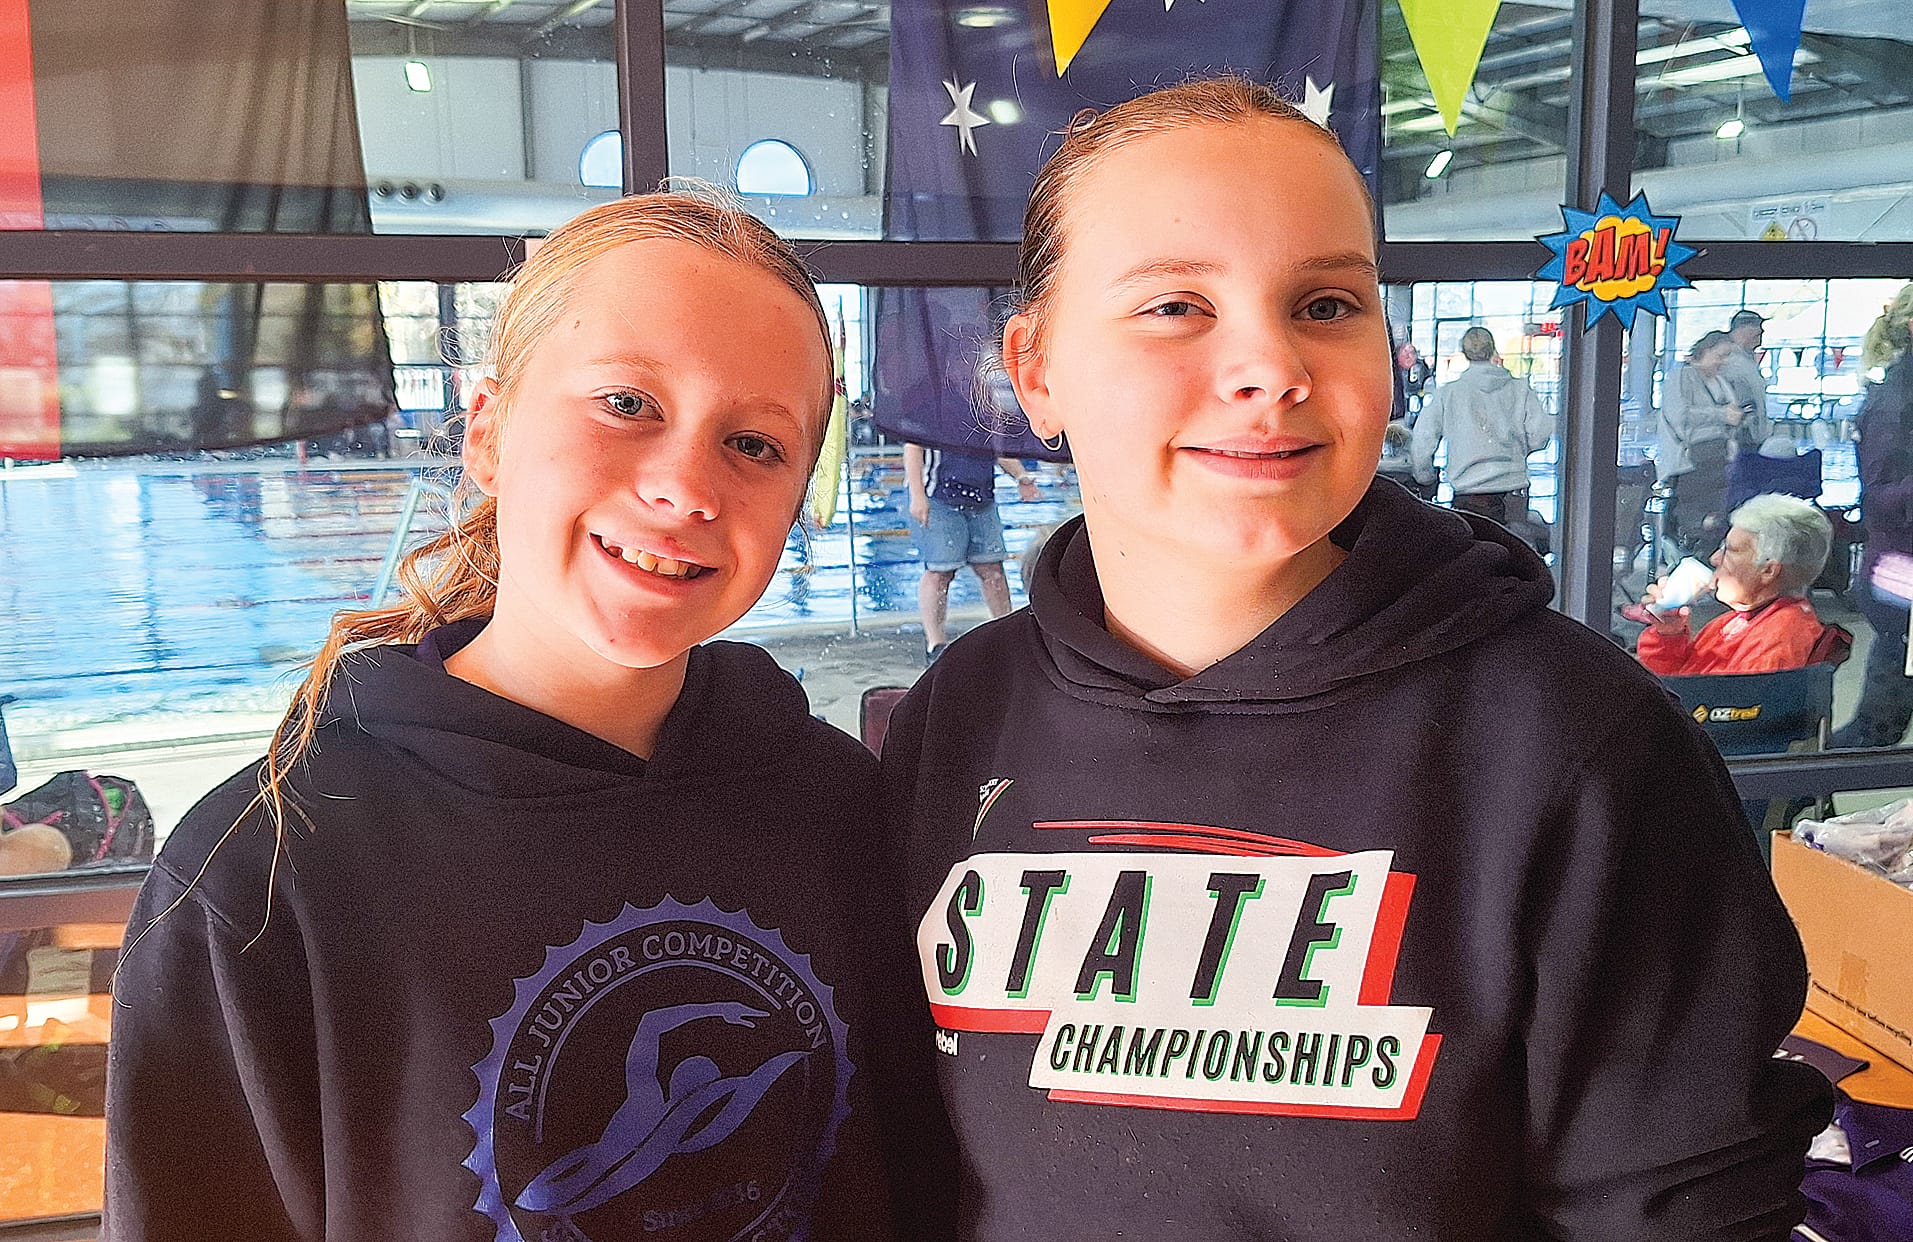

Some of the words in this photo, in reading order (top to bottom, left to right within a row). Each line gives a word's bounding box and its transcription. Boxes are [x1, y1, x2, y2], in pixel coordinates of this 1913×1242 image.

[1563, 226, 1671, 286] BAM!
[936, 869, 1358, 1007] STATE
[505, 1054, 542, 1121] ALL
[528, 945, 636, 1047] JUNIOR
[642, 931, 829, 1050] COMPETITION
[1050, 1023, 1401, 1089] CHAMPIONSHIPS
